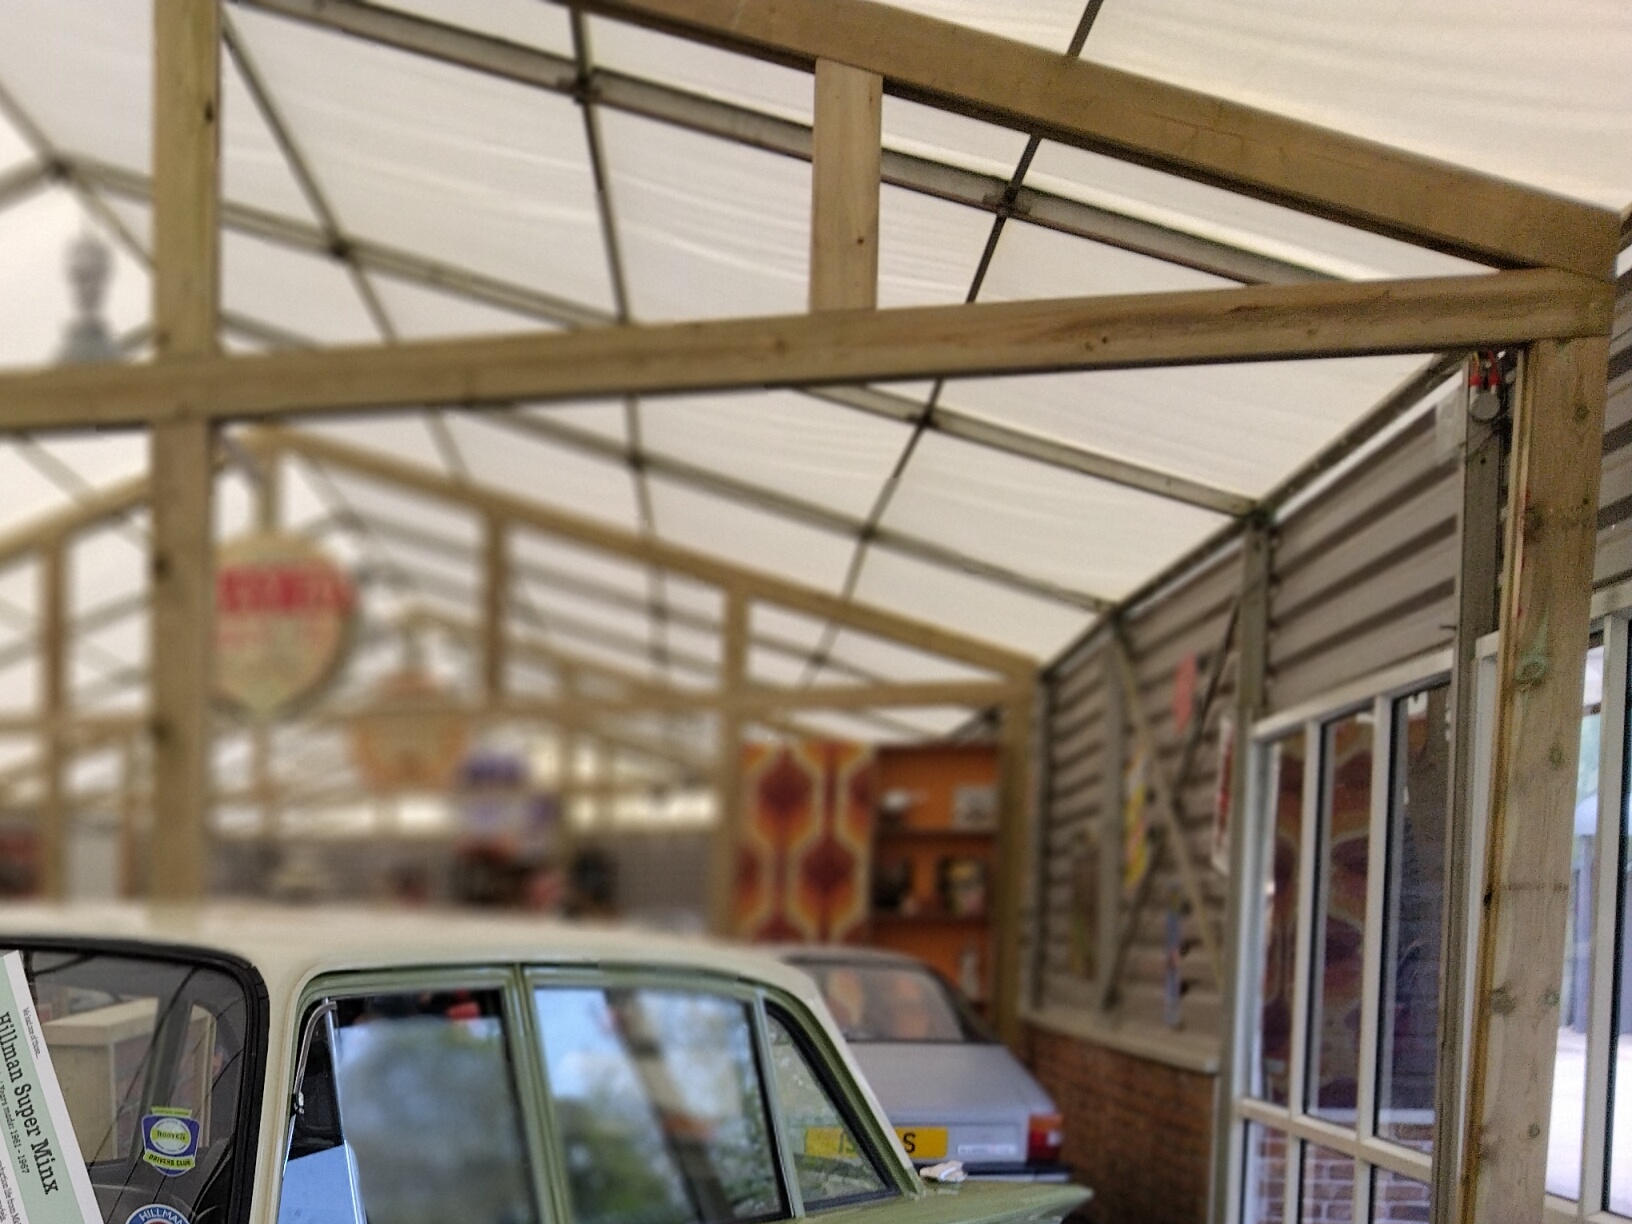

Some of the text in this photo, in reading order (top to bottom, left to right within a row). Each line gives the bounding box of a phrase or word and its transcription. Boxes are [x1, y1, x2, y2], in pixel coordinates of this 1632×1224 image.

[9, 1129, 22, 1148] 1961
[16, 1153, 30, 1174] 1967
[13, 1083, 41, 1137] Super
[30, 1137, 58, 1195] Minx
